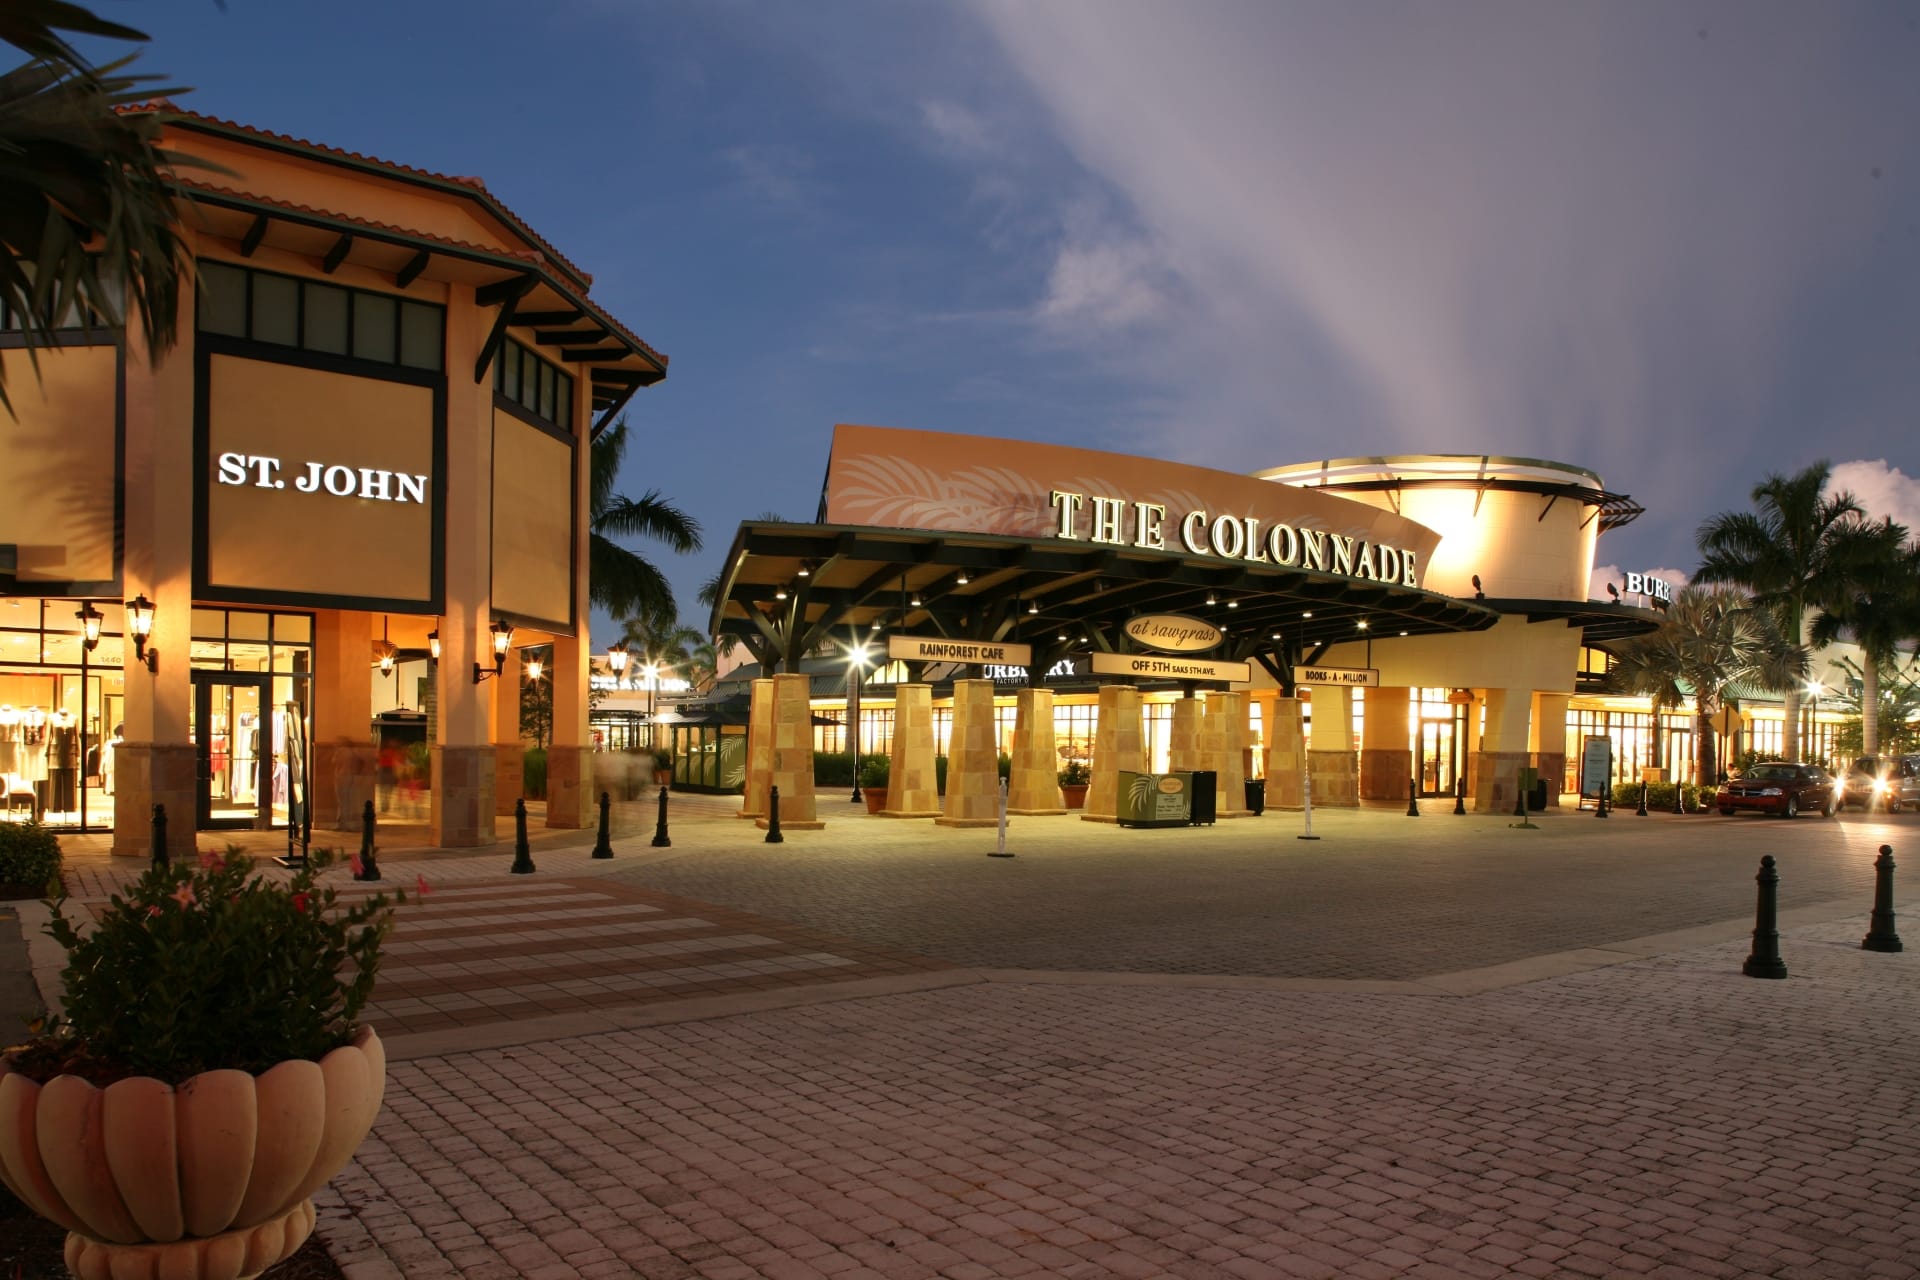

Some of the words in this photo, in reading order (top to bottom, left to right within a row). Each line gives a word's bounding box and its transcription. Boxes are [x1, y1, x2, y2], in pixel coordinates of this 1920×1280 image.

[218, 452, 285, 489] ST.
[295, 462, 428, 504] JOHN
[1053, 490, 1166, 551] THE
[1181, 510, 1418, 588] COLONNADE
[1627, 572, 1670, 602] BURB
[1131, 620, 1151, 635] at
[1151, 622, 1216, 646] sawgrass
[919, 643, 979, 658] RAINFOREST
[981, 647, 1004, 660] CAFE
[1131, 660, 1151, 671] OFF
[1152, 662, 1170, 672] 5TH
[1172, 665, 1189, 674] SAKS
[1305, 671, 1327, 680] BOOKS
[1342, 673, 1368, 683] MILLION
